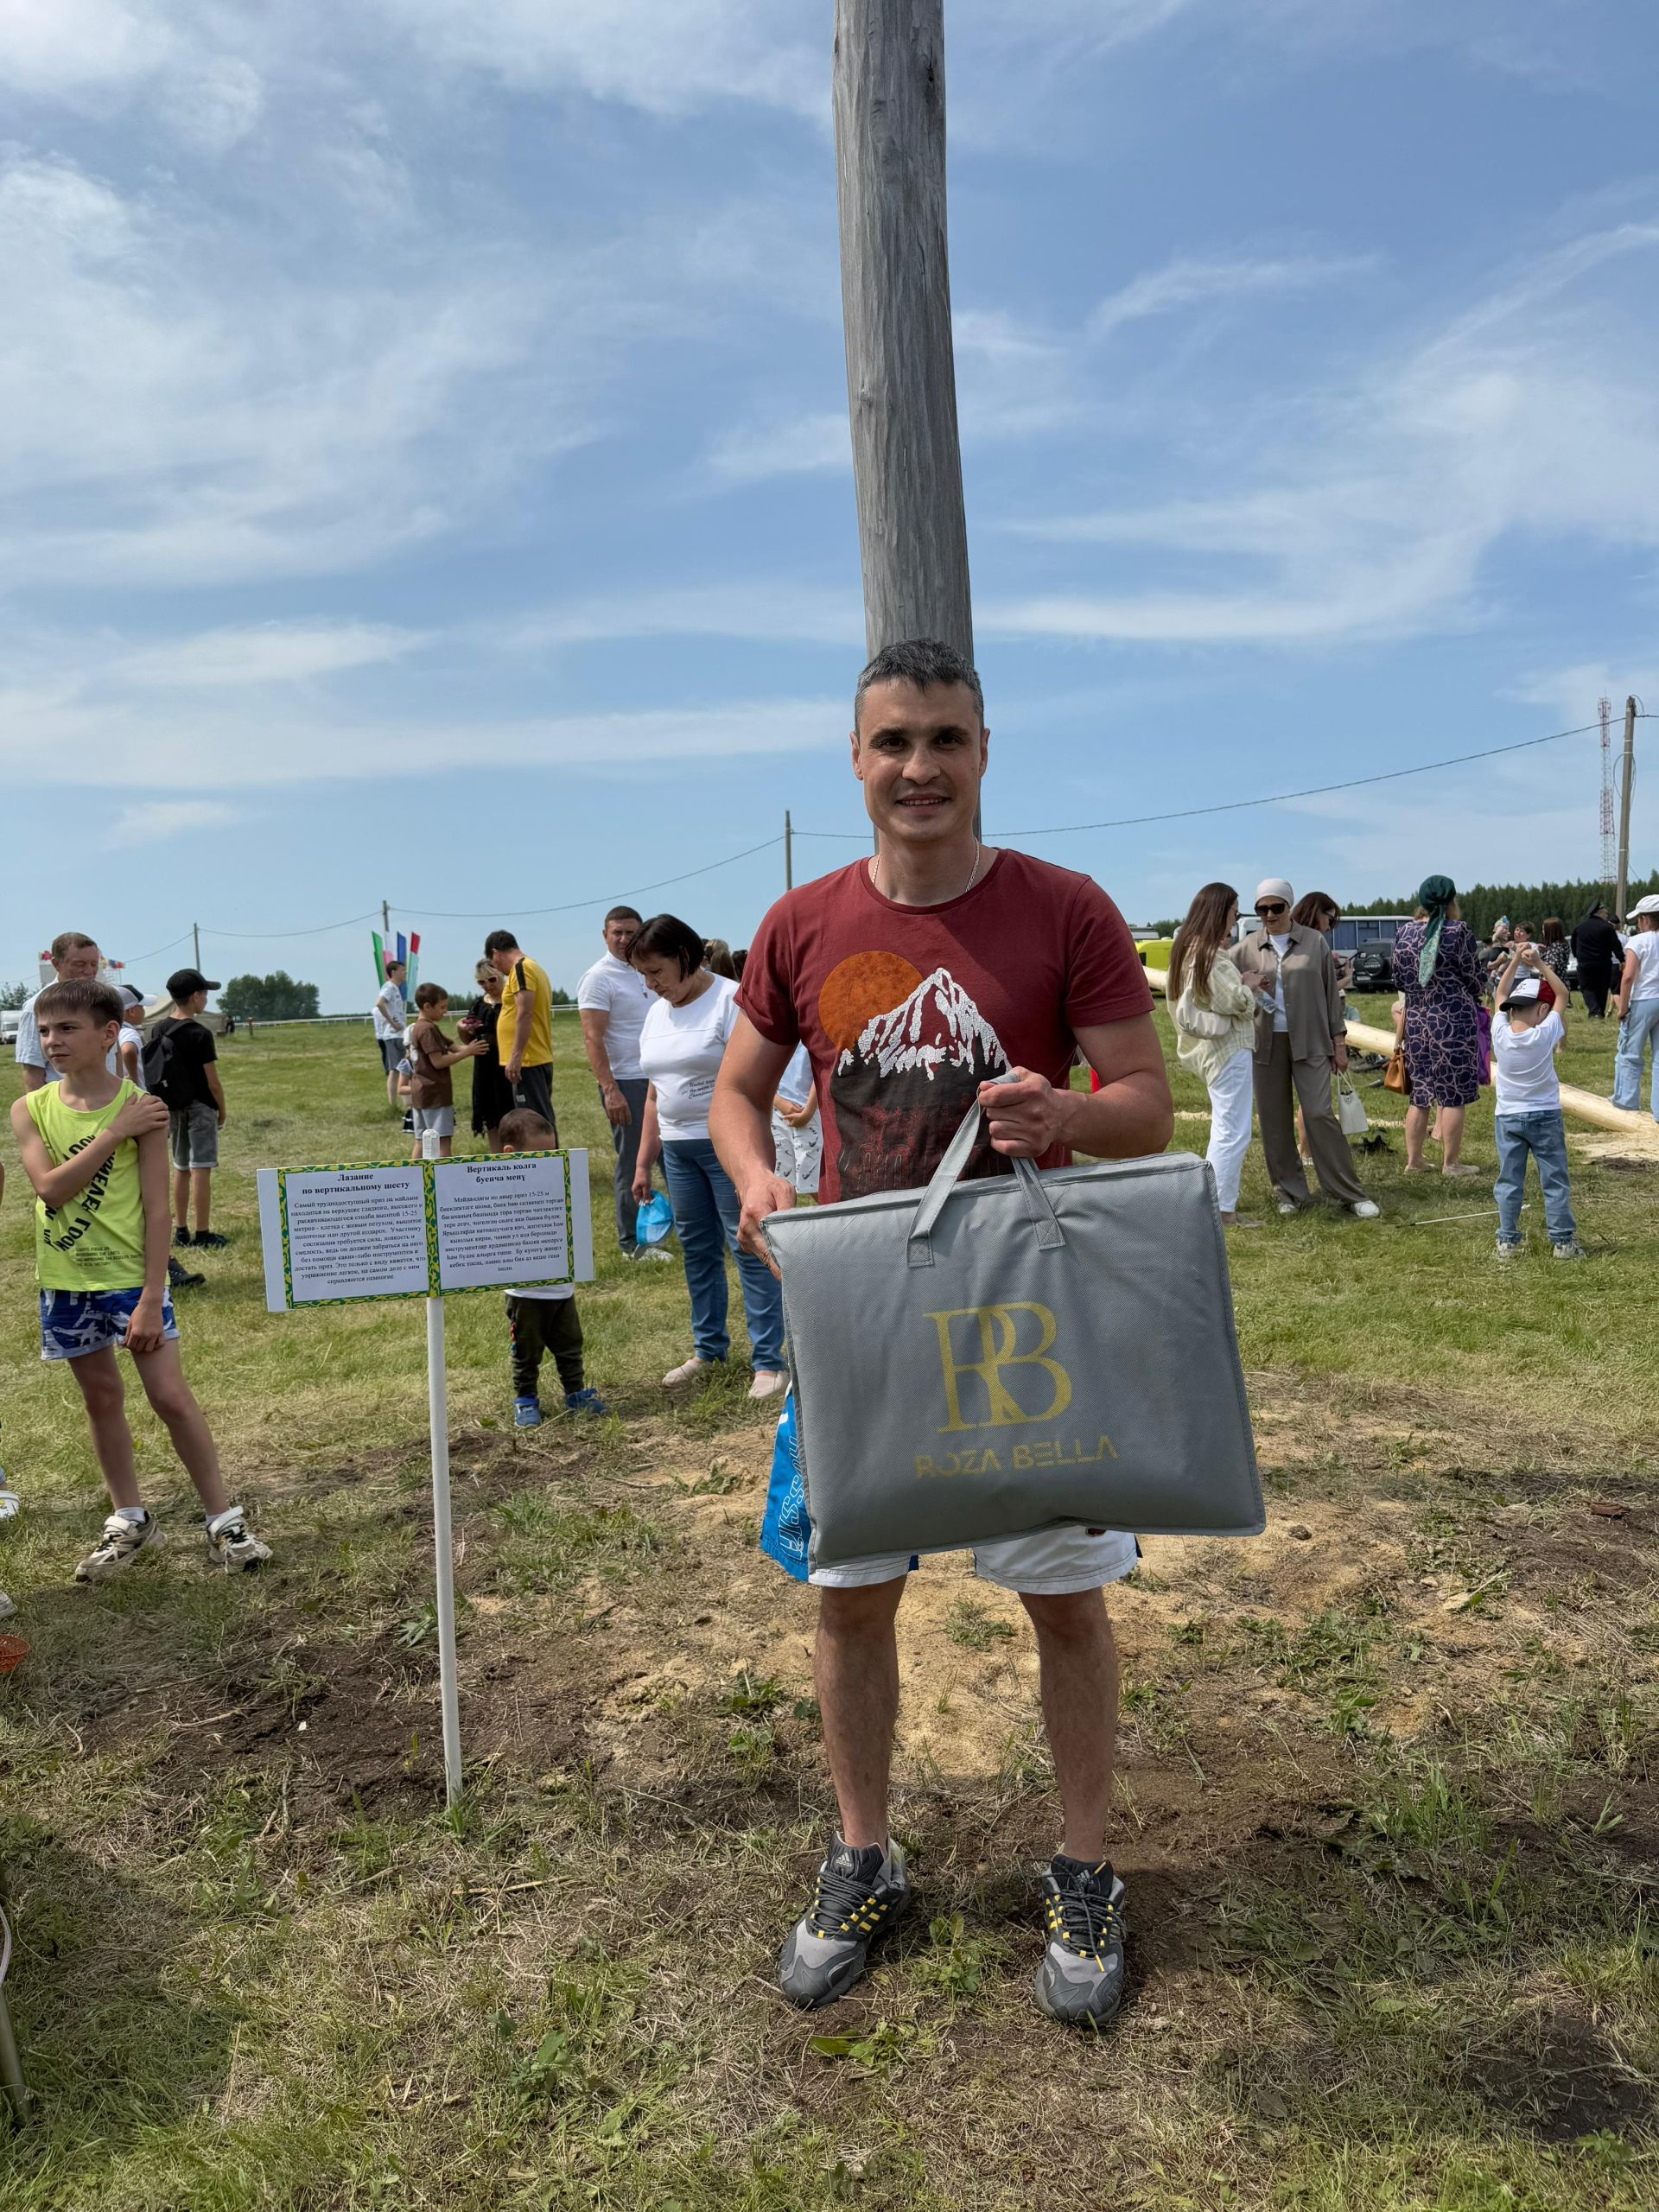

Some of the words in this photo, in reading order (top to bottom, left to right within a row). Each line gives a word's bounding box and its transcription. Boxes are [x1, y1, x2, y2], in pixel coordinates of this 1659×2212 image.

[467, 1163, 511, 1174] Вертикаль
[337, 1173, 373, 1181] Лазание
[475, 1174, 504, 1185] буенча
[315, 1184, 381, 1195] вертикальному
[384, 1182, 410, 1191] шесту
[914, 1448, 1002, 1479] ROZA
[1012, 1435, 1119, 1471] BELLA
